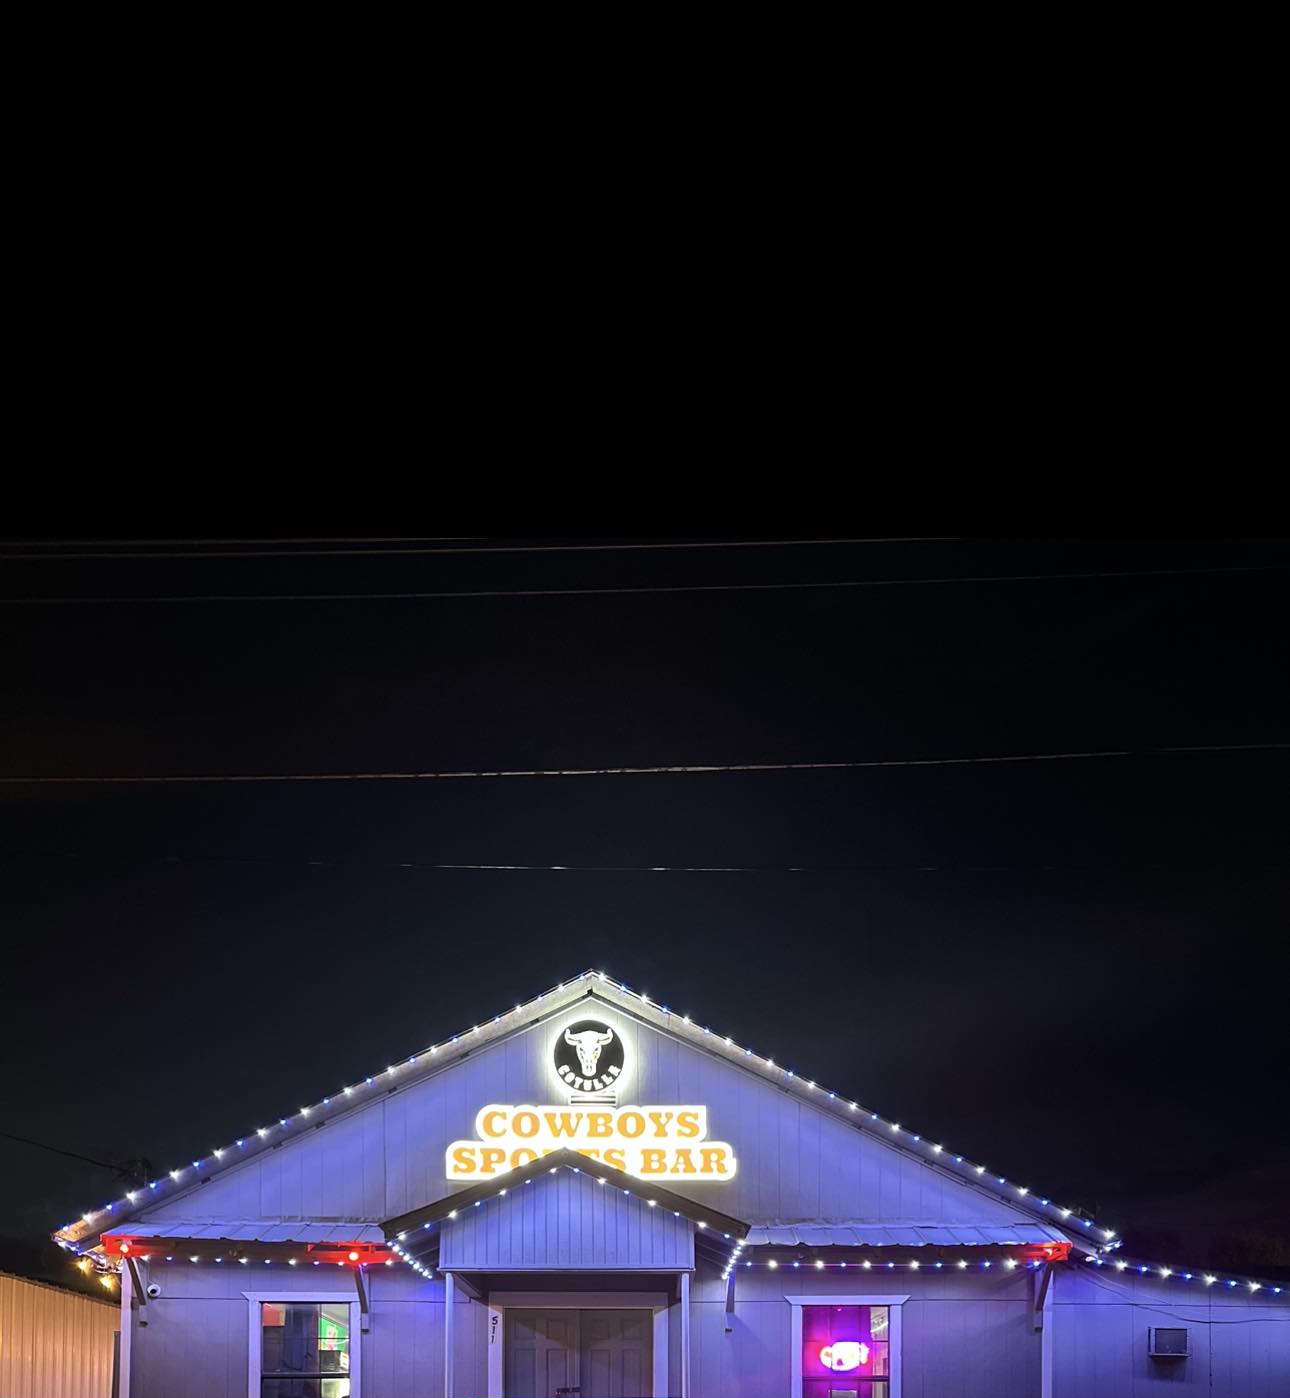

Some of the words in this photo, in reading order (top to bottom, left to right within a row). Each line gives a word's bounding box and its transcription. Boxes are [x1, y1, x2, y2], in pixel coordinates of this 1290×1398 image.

[557, 1064, 621, 1092] COTULLA
[482, 1111, 700, 1138] COWBOYS
[452, 1147, 626, 1174] SPOS
[640, 1148, 728, 1174] BAR
[490, 1315, 499, 1344] 511
